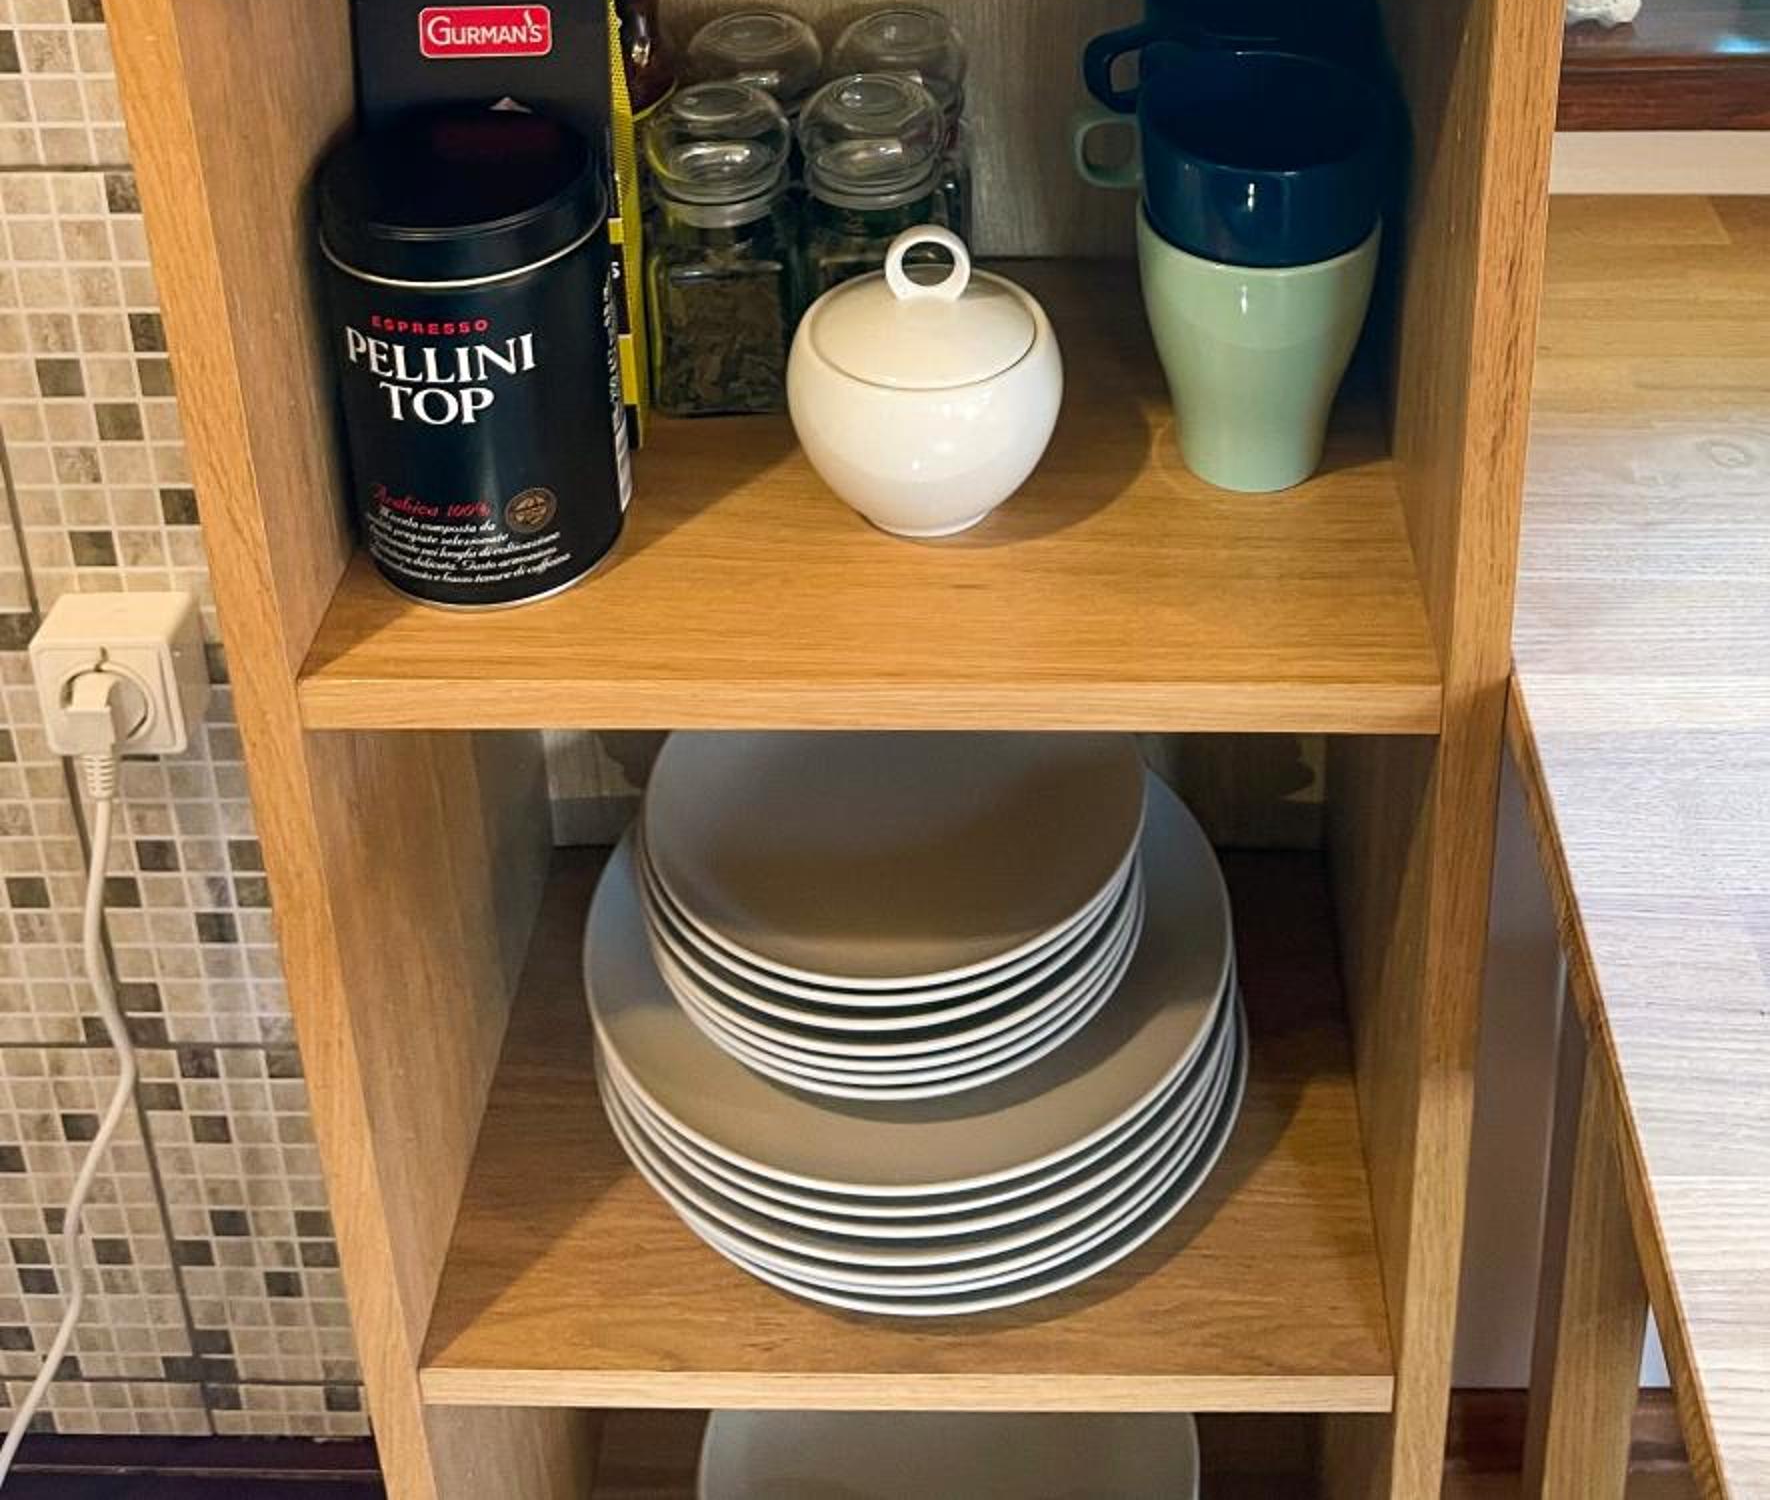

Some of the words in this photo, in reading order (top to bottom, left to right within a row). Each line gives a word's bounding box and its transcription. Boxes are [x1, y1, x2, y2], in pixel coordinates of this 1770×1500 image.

[427, 11, 546, 47] GURMAN'S
[371, 315, 490, 335] ESPRESSO
[345, 325, 536, 384] PELLINI
[379, 381, 494, 425] TOP
